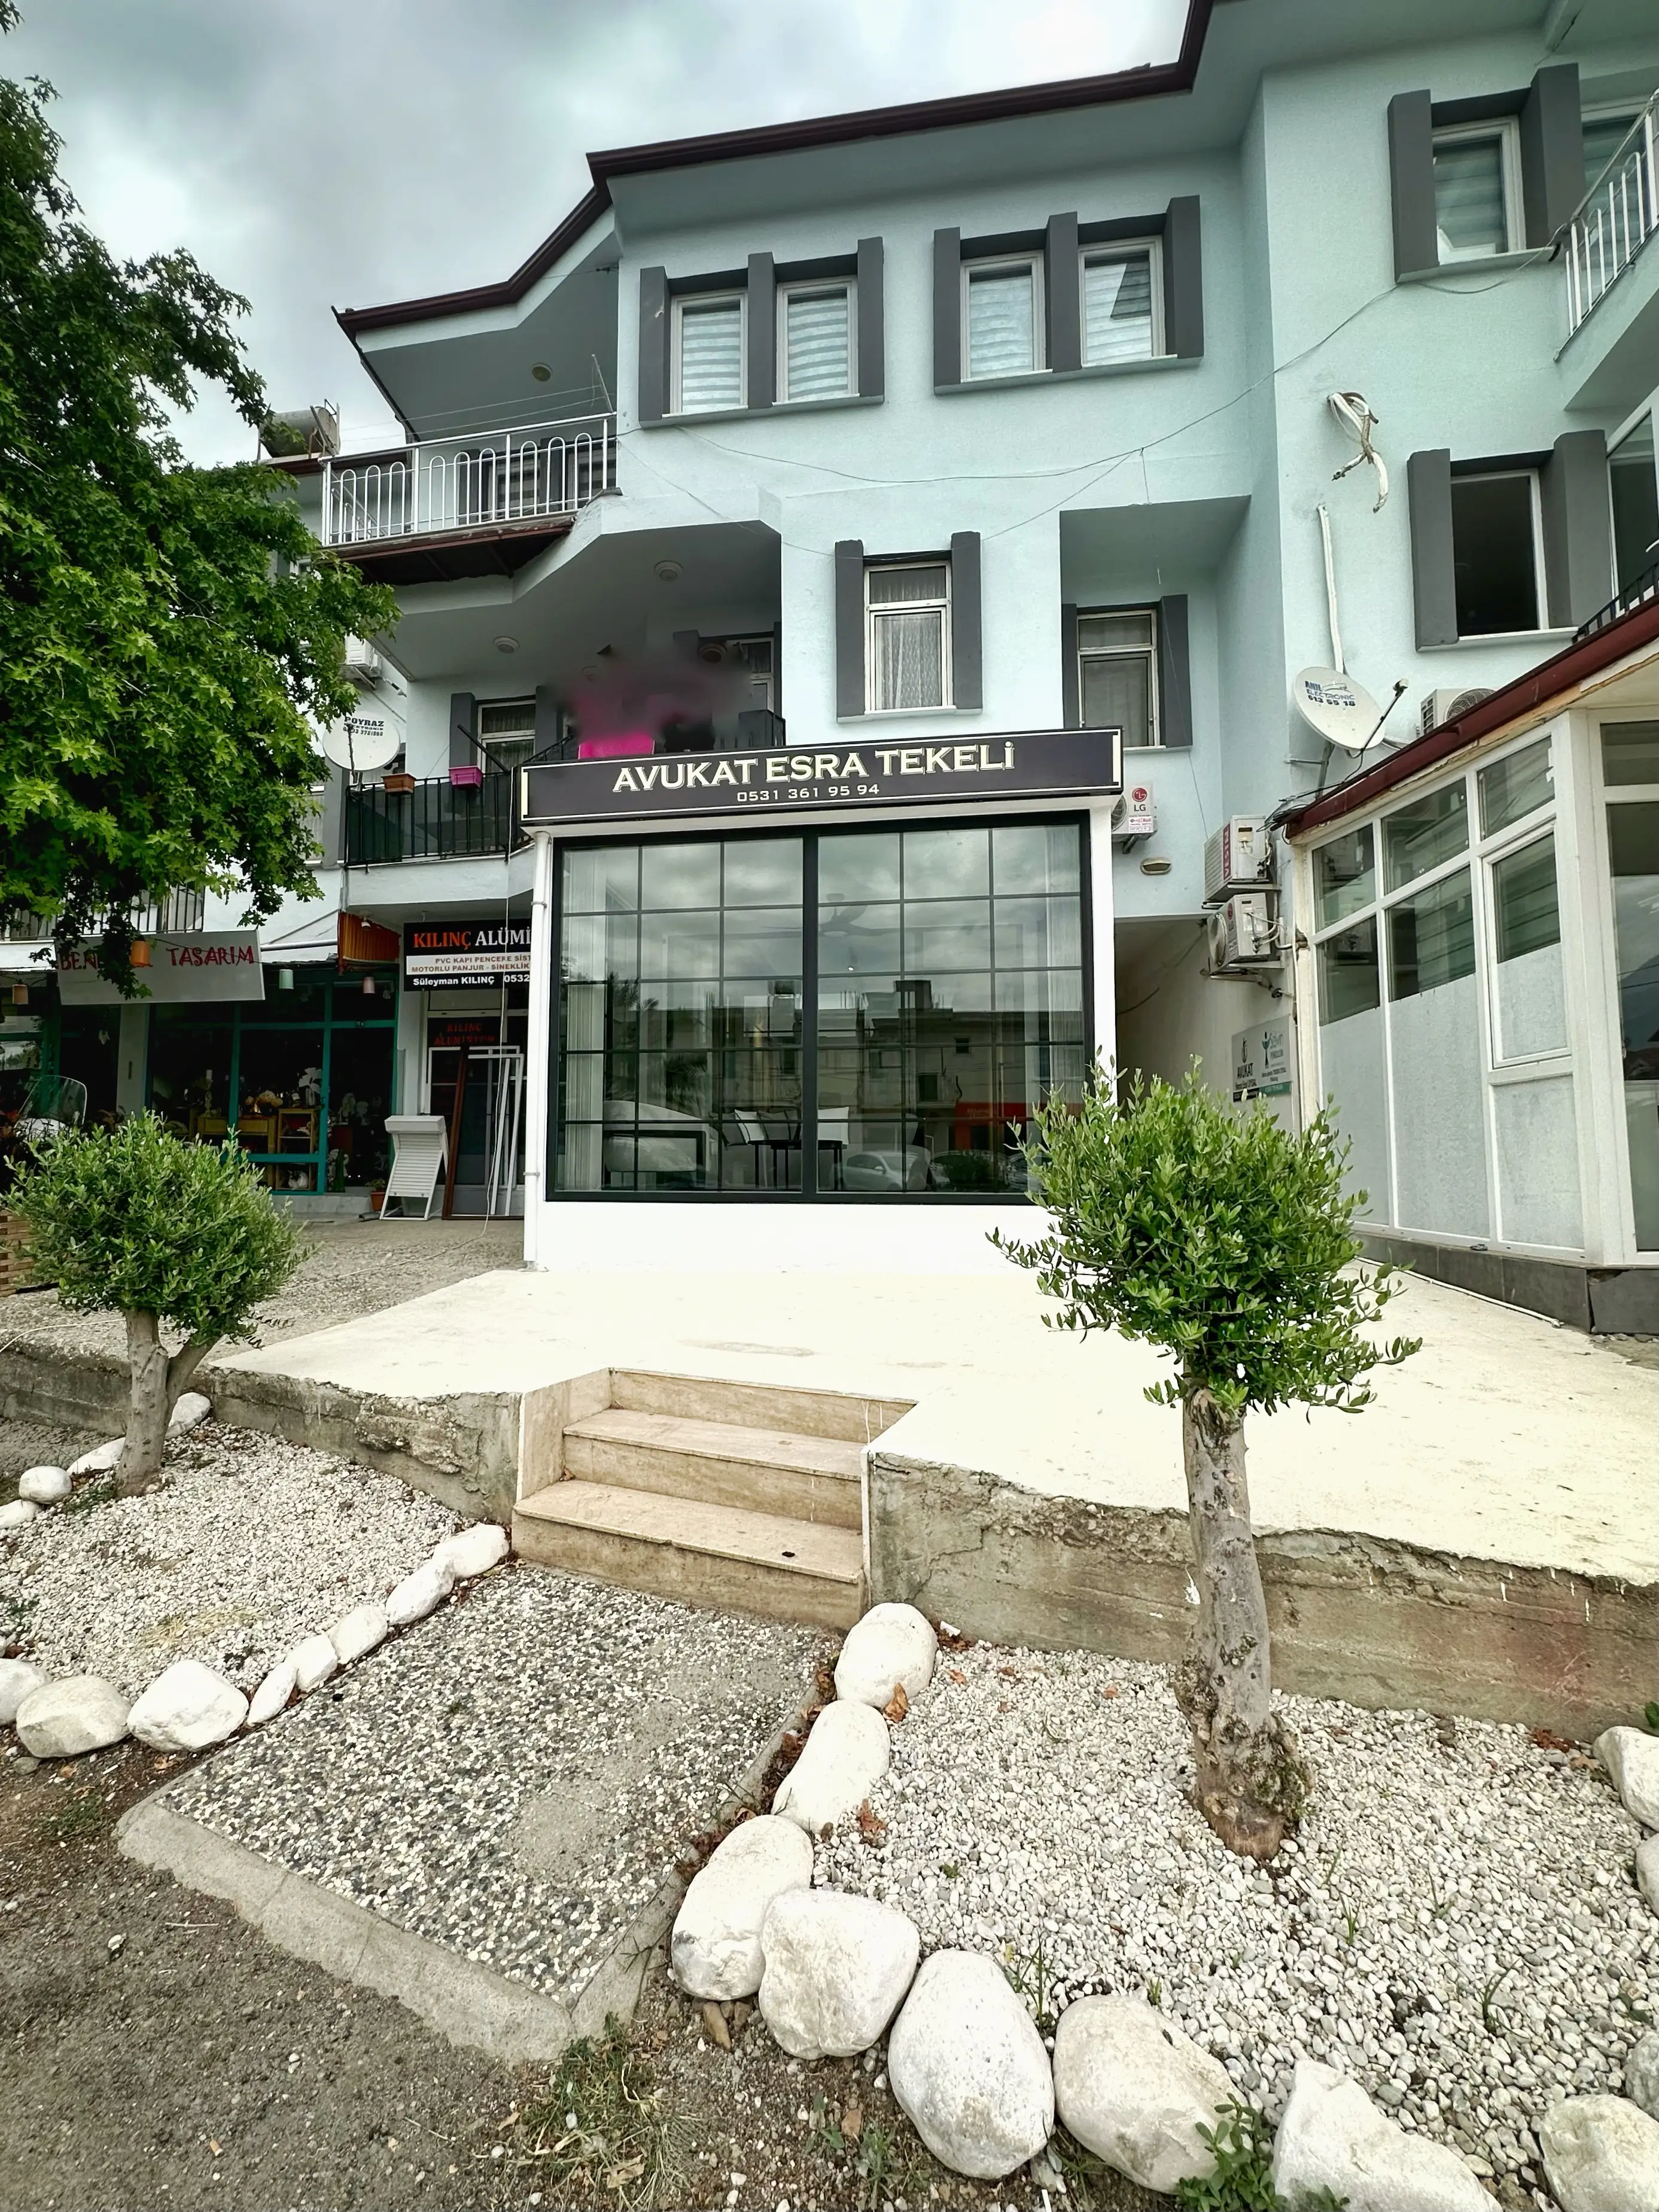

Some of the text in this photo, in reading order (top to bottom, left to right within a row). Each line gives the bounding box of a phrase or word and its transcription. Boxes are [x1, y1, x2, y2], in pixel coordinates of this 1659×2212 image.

[1306, 688, 1355, 700] ELECTRONIC
[345, 716, 385, 727] POYRAZ
[613, 757, 758, 793] AVUKAT
[766, 752, 869, 783] ESRA
[736, 784, 879, 802] 0531 361 95 94
[1134, 804, 1146, 812] LG
[413, 931, 471, 950] KILINÇ
[166, 945, 255, 967] TASARIM
[413, 974, 530, 987] Süleyman KILINÇ 0532
